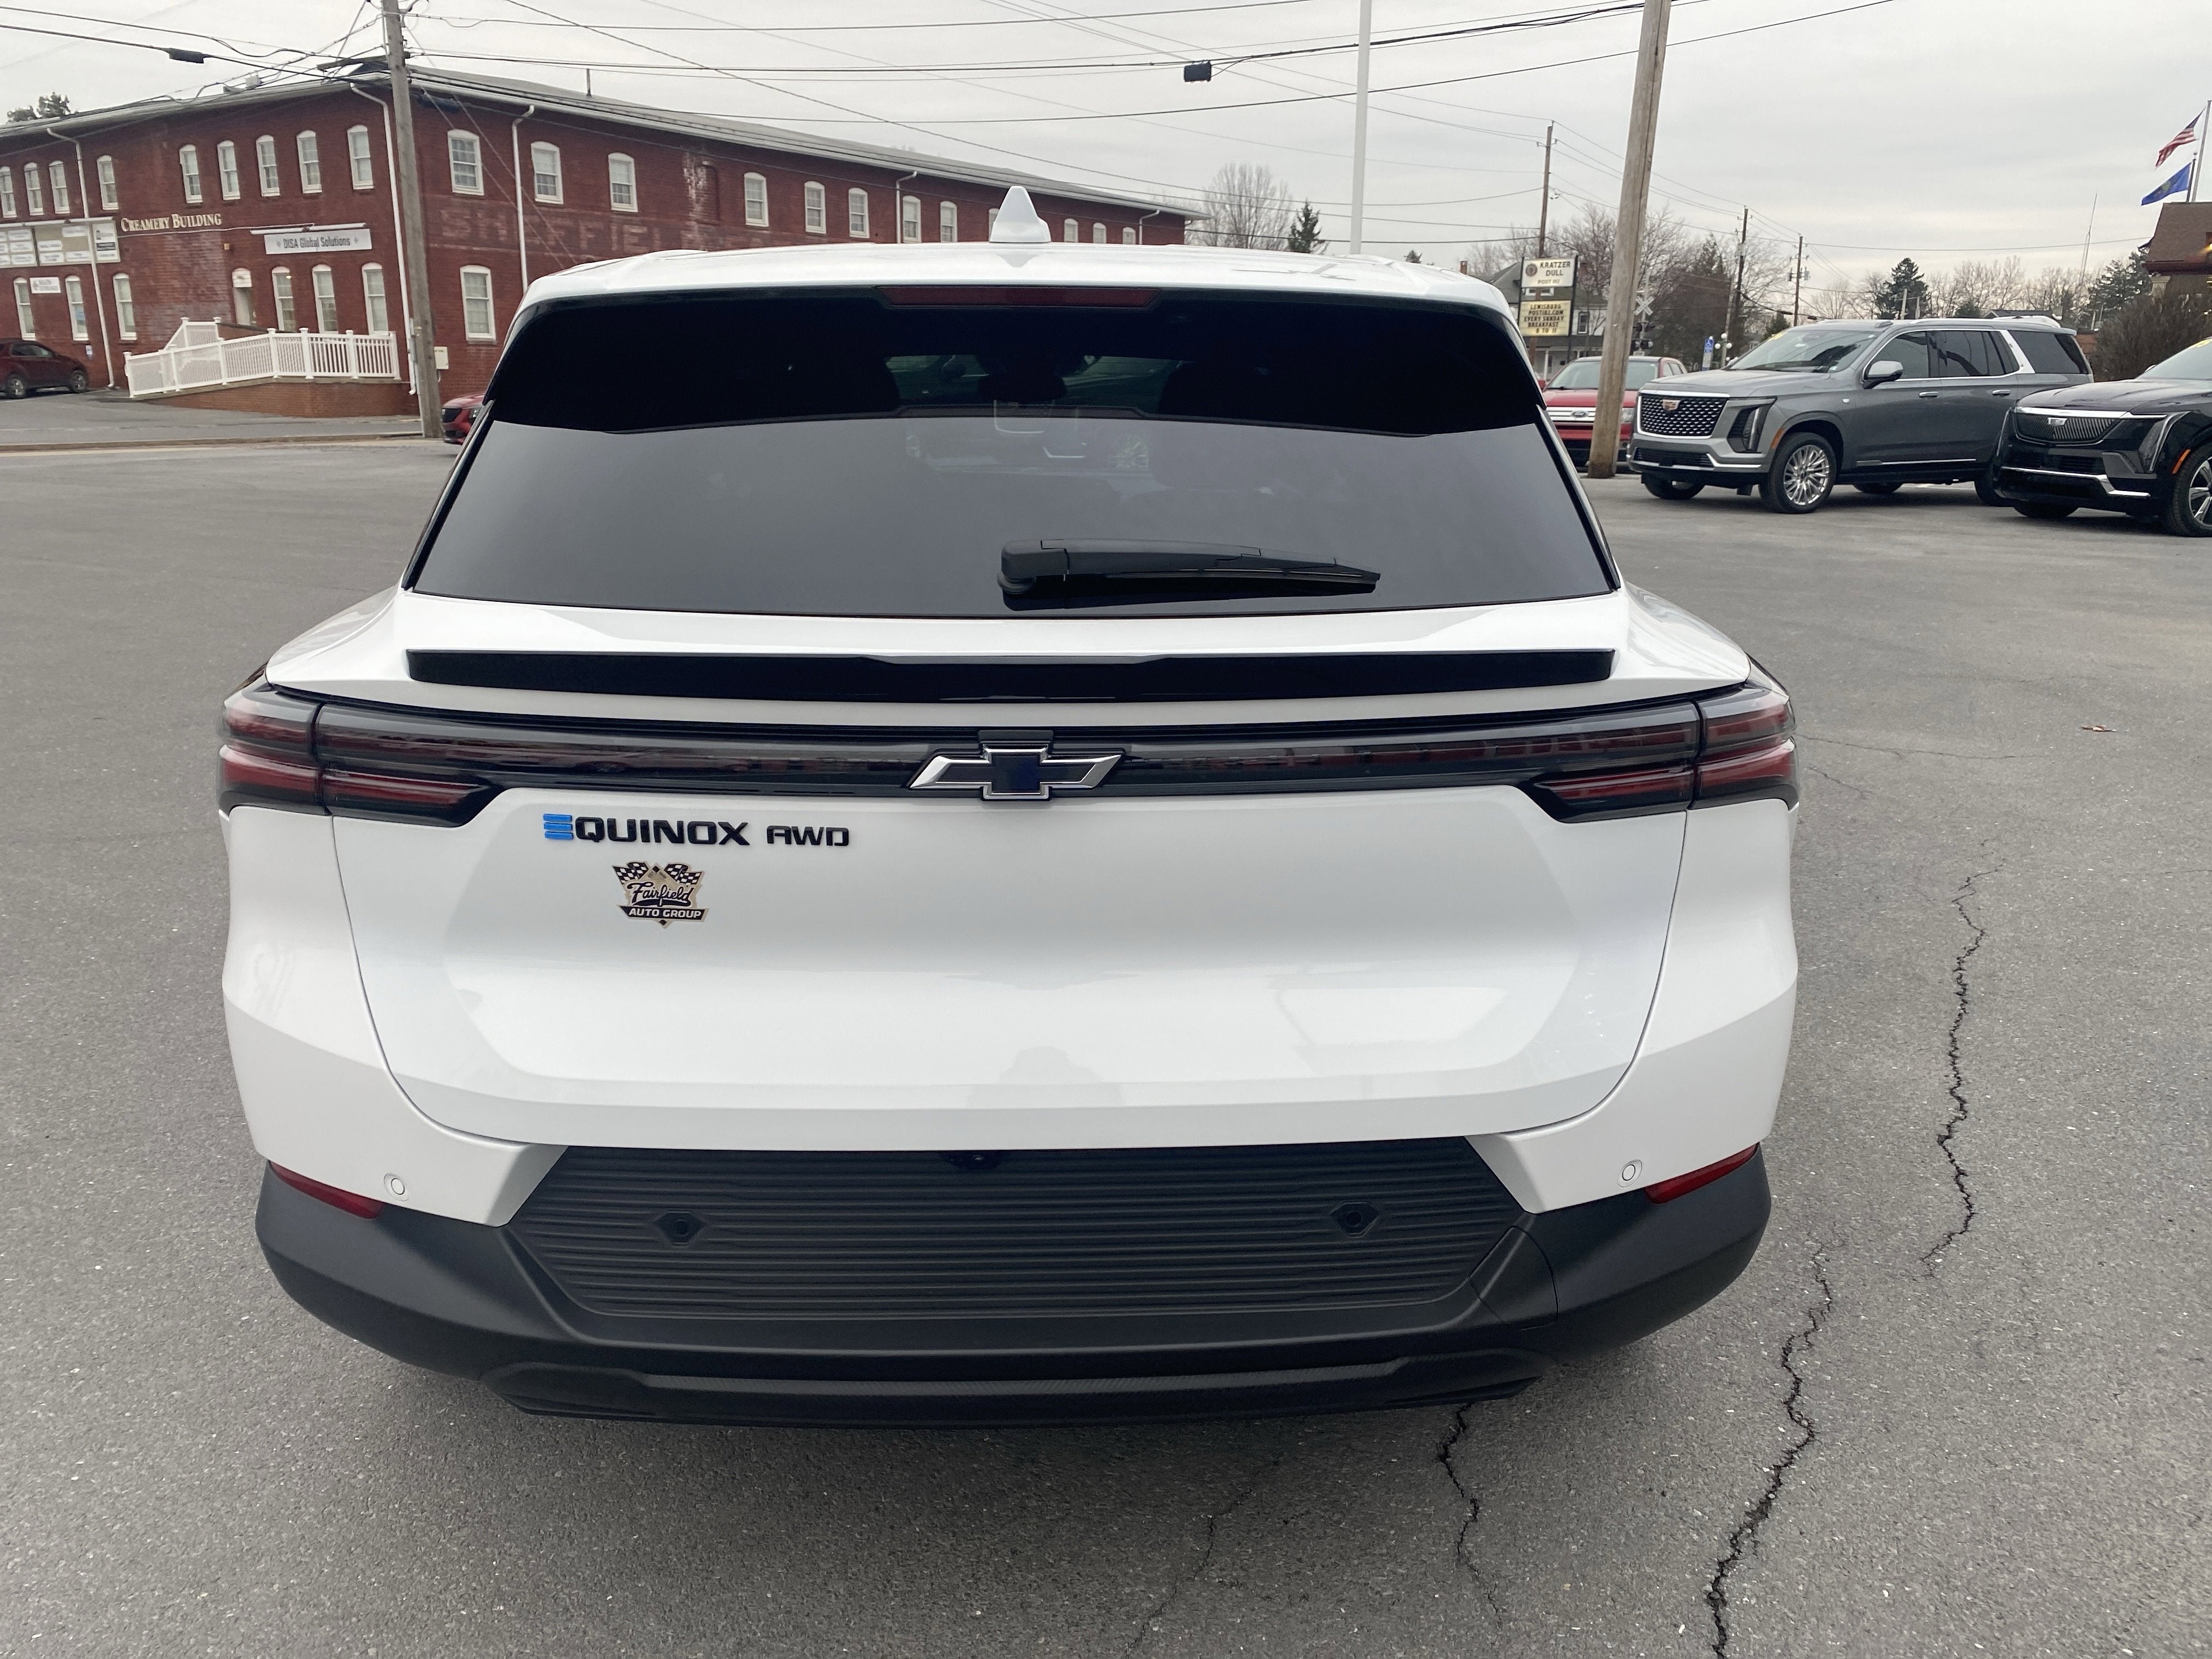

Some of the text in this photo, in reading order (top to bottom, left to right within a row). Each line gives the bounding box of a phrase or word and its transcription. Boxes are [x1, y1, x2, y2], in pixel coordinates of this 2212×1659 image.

[121, 213, 222, 232] CREAMERY BUILDING
[283, 236, 350, 249] DISA Global Solutions
[543, 814, 849, 847] EQUINOX AWD
[627, 882, 695, 907] Fairfield
[629, 908, 702, 918] AUTO GROUP
